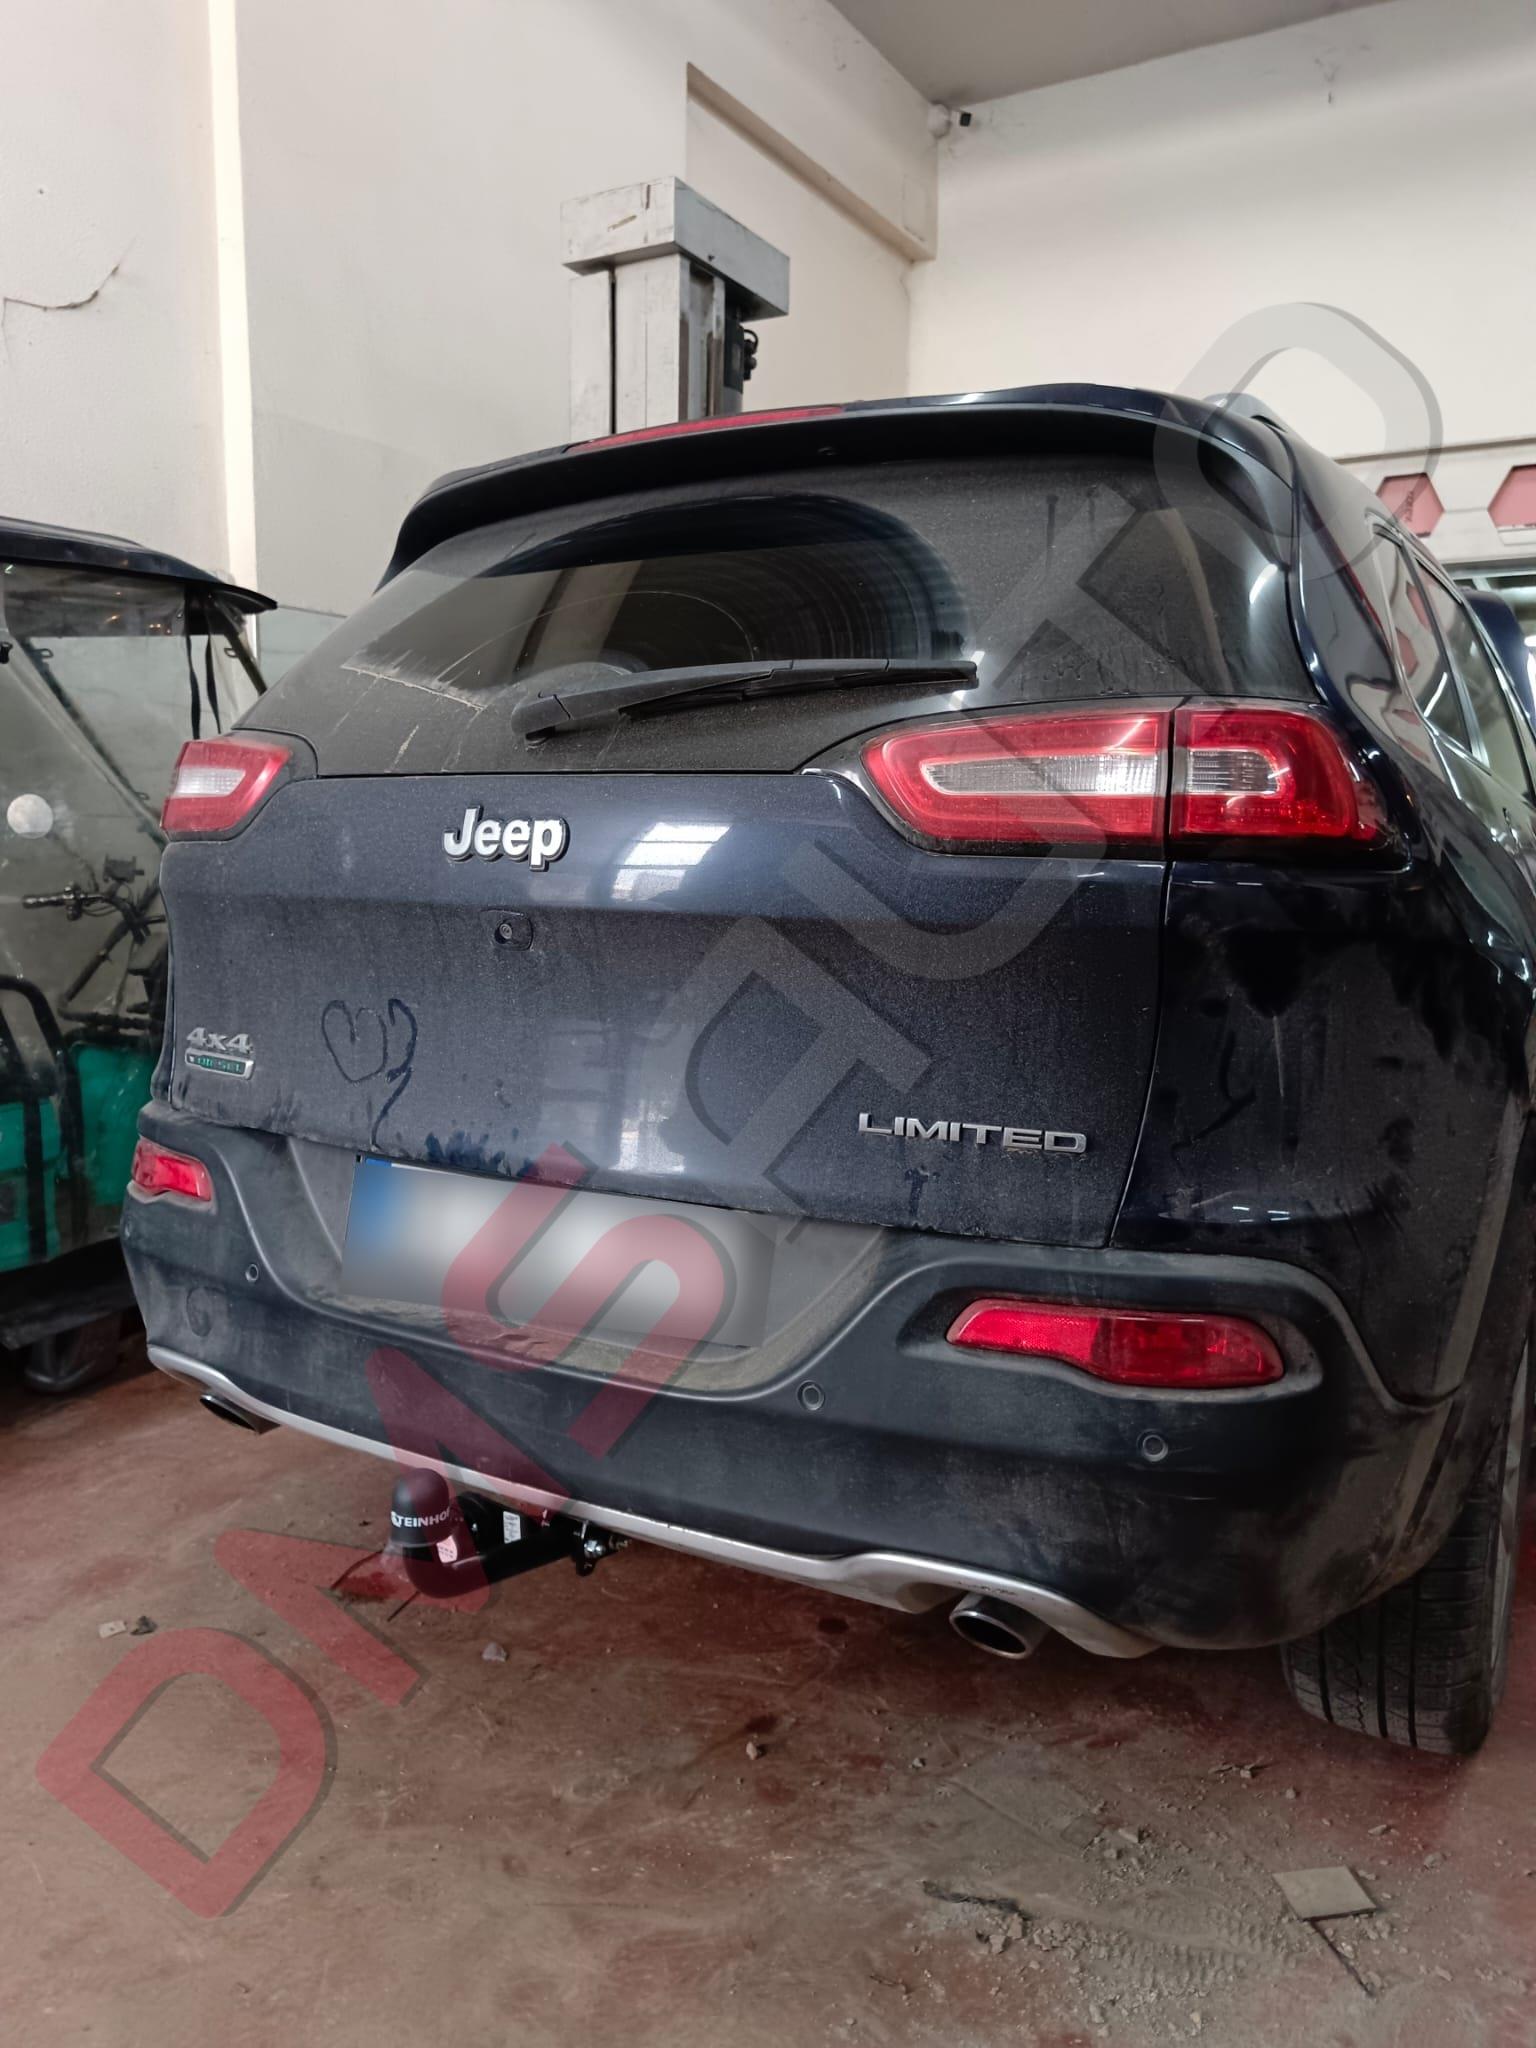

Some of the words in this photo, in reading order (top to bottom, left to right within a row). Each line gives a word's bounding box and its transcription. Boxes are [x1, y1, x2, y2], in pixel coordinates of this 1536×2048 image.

[443, 805, 570, 872] Jeep
[186, 1027, 252, 1053] 4x4
[858, 1112, 1087, 1153] LIMITED
